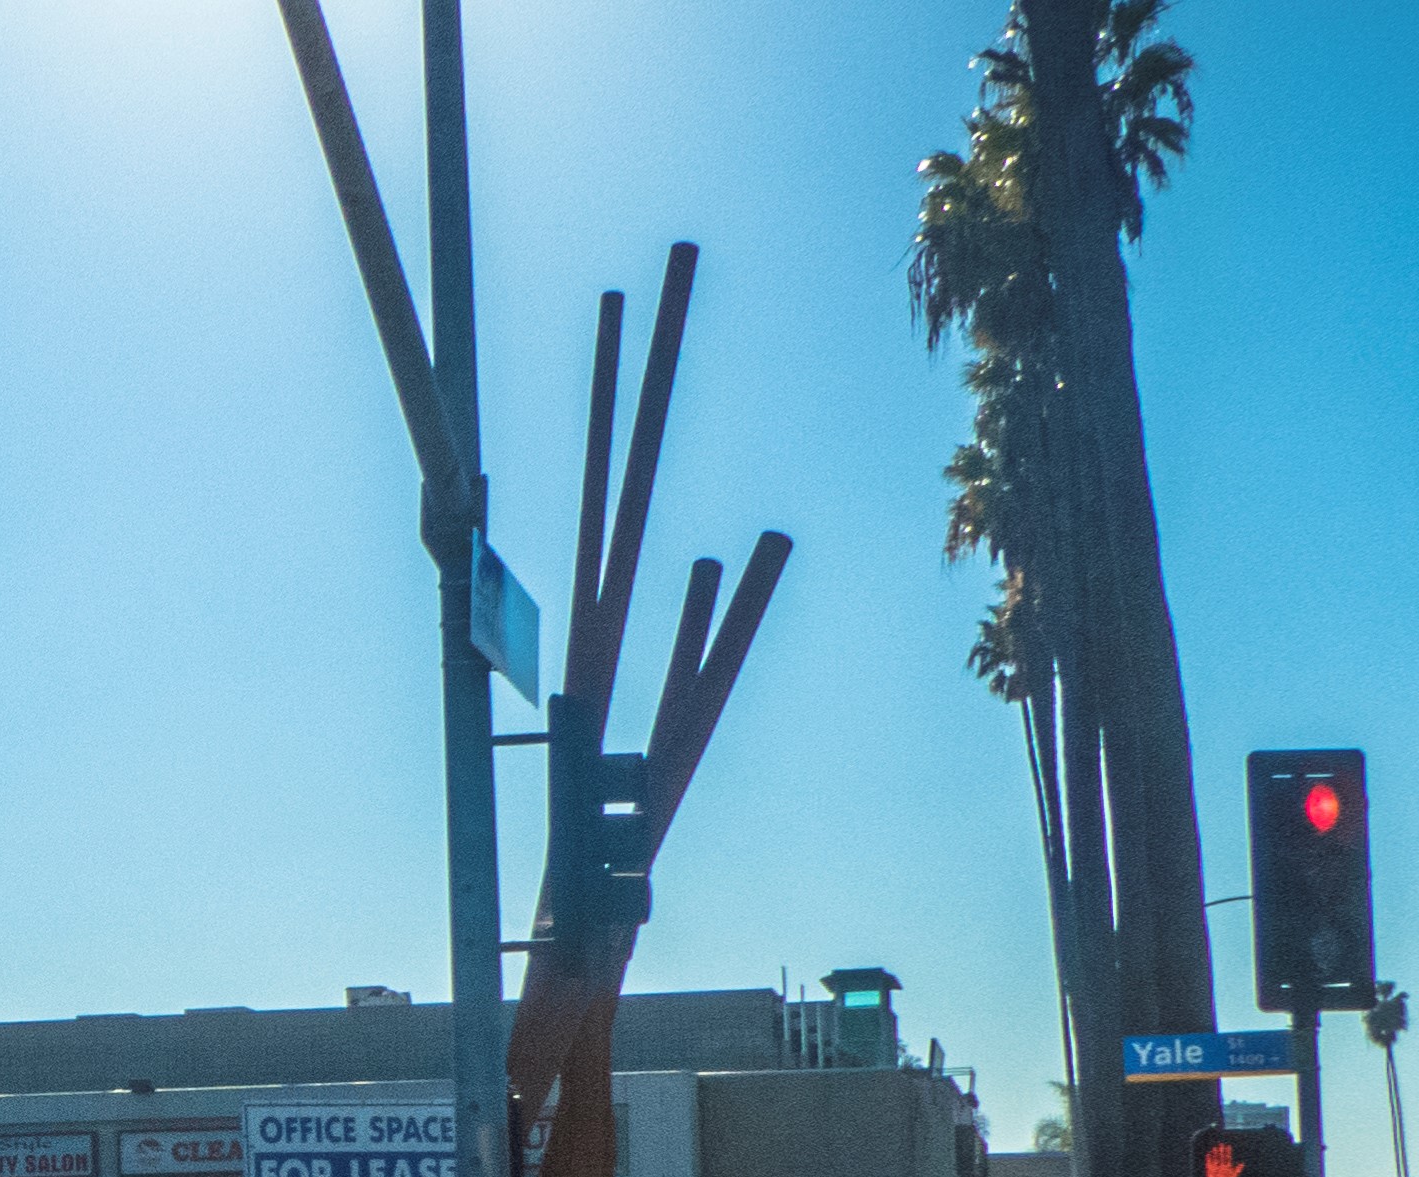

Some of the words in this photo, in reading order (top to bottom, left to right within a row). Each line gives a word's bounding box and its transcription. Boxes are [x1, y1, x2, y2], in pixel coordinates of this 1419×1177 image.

[1131, 1038, 1204, 1067] Yale
[1227, 1037, 1245, 1050] St
[259, 1115, 358, 1144] OFFICE
[369, 1115, 455, 1145] SPACE
[24, 1153, 88, 1175] SALON
